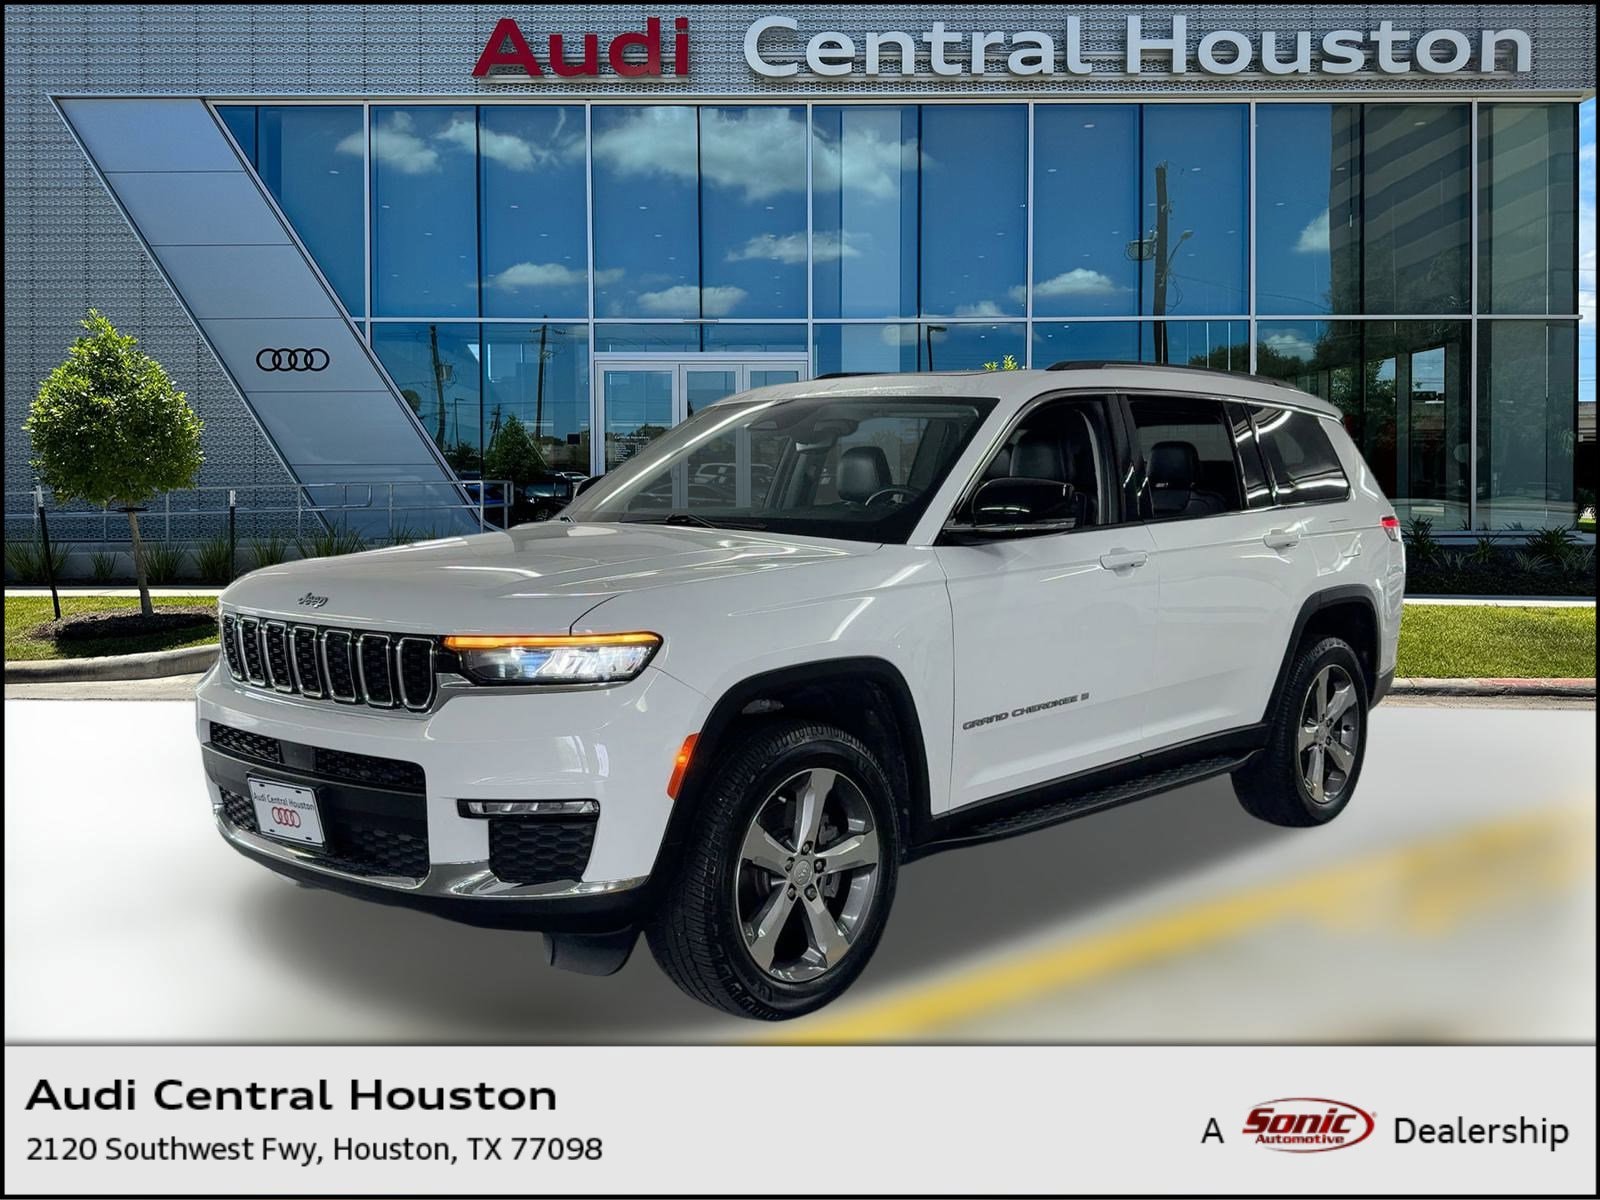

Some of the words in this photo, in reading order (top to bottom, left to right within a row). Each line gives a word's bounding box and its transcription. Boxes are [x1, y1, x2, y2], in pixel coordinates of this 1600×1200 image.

[471, 17, 689, 78] Audi
[743, 15, 1094, 78] Central
[1126, 15, 1532, 76] Houston
[297, 591, 329, 609] Jeep
[962, 711, 1009, 731] GRAND
[1011, 694, 1078, 718] CHEROKEE
[267, 794, 288, 806] Central
[288, 800, 315, 811] Houston
